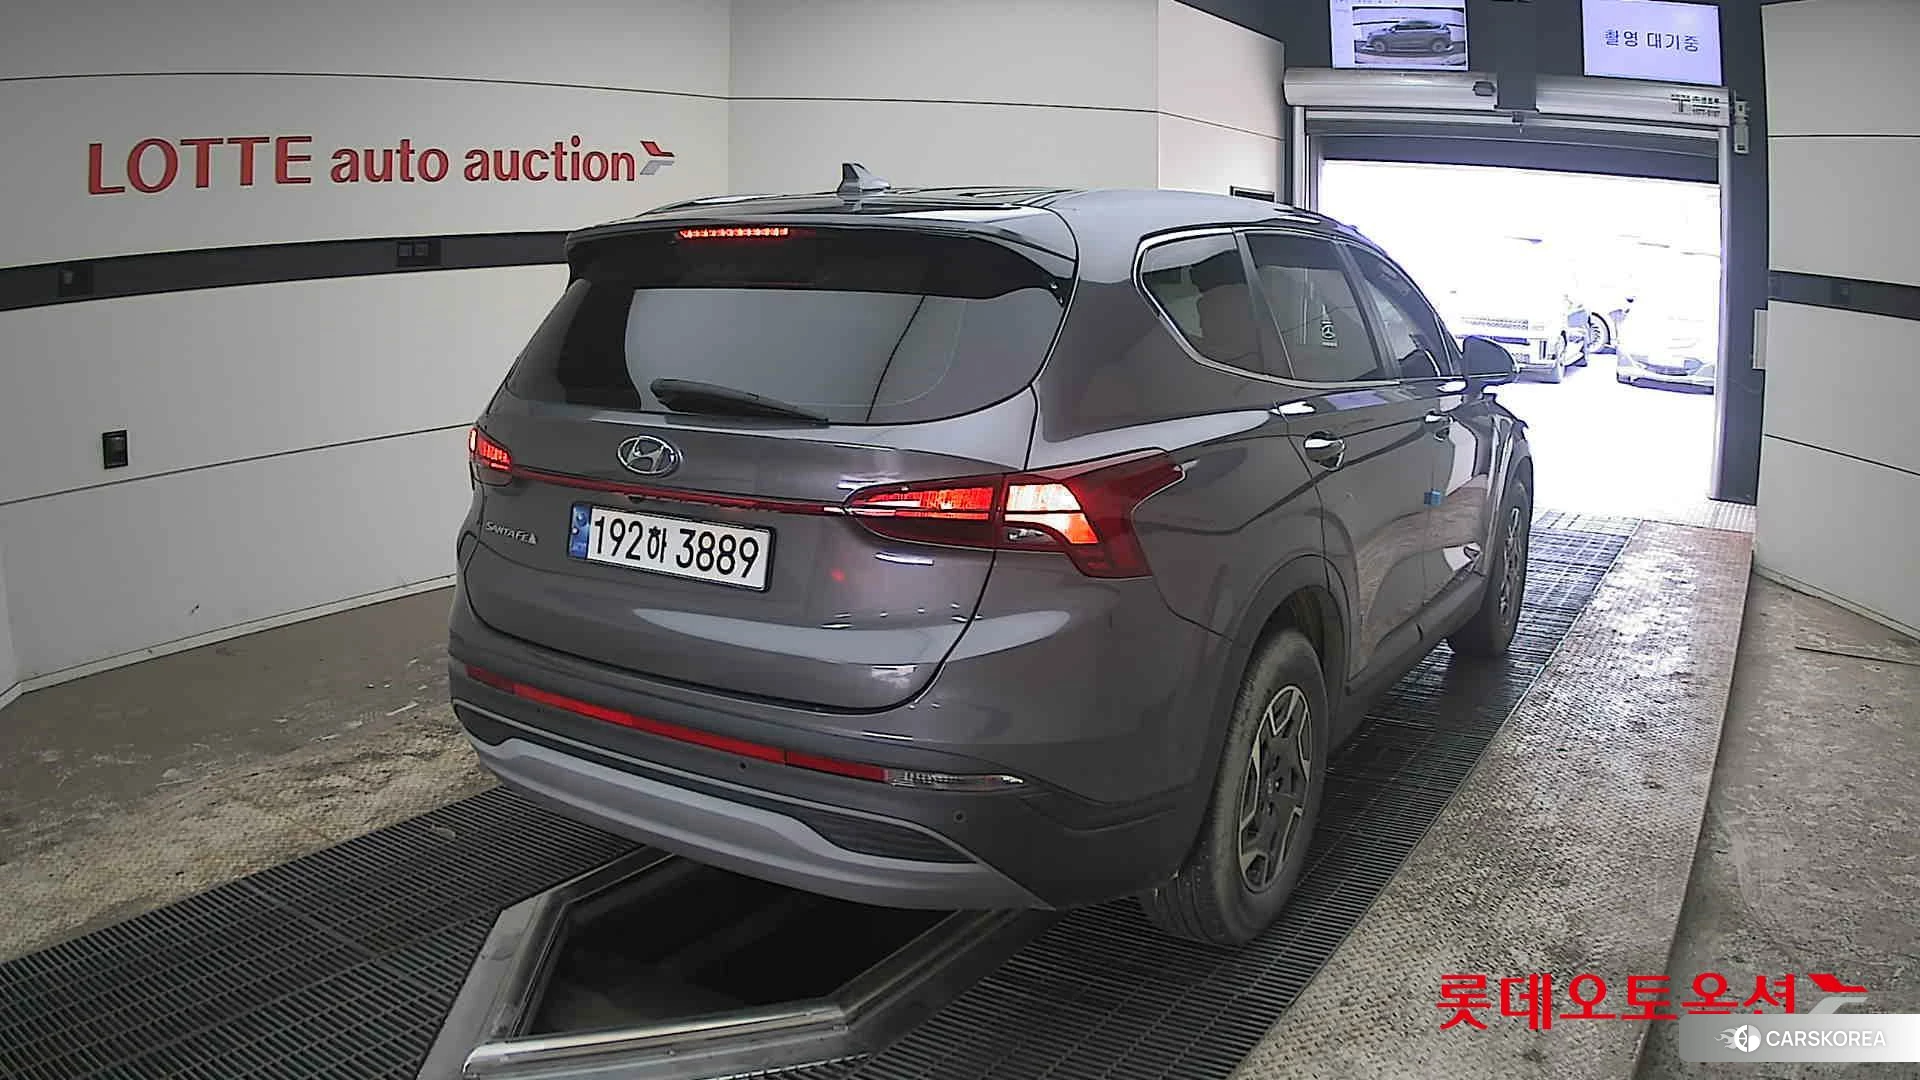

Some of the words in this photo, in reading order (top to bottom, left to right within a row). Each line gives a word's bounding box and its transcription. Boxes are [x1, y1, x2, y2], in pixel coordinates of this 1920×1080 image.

[1647, 32, 1698, 52] 대기중
[88, 136, 312, 195] LOTTE
[330, 139, 449, 183] auto
[463, 135, 635, 182] auction
[594, 515, 668, 563] 192하
[675, 528, 760, 579] 3889
